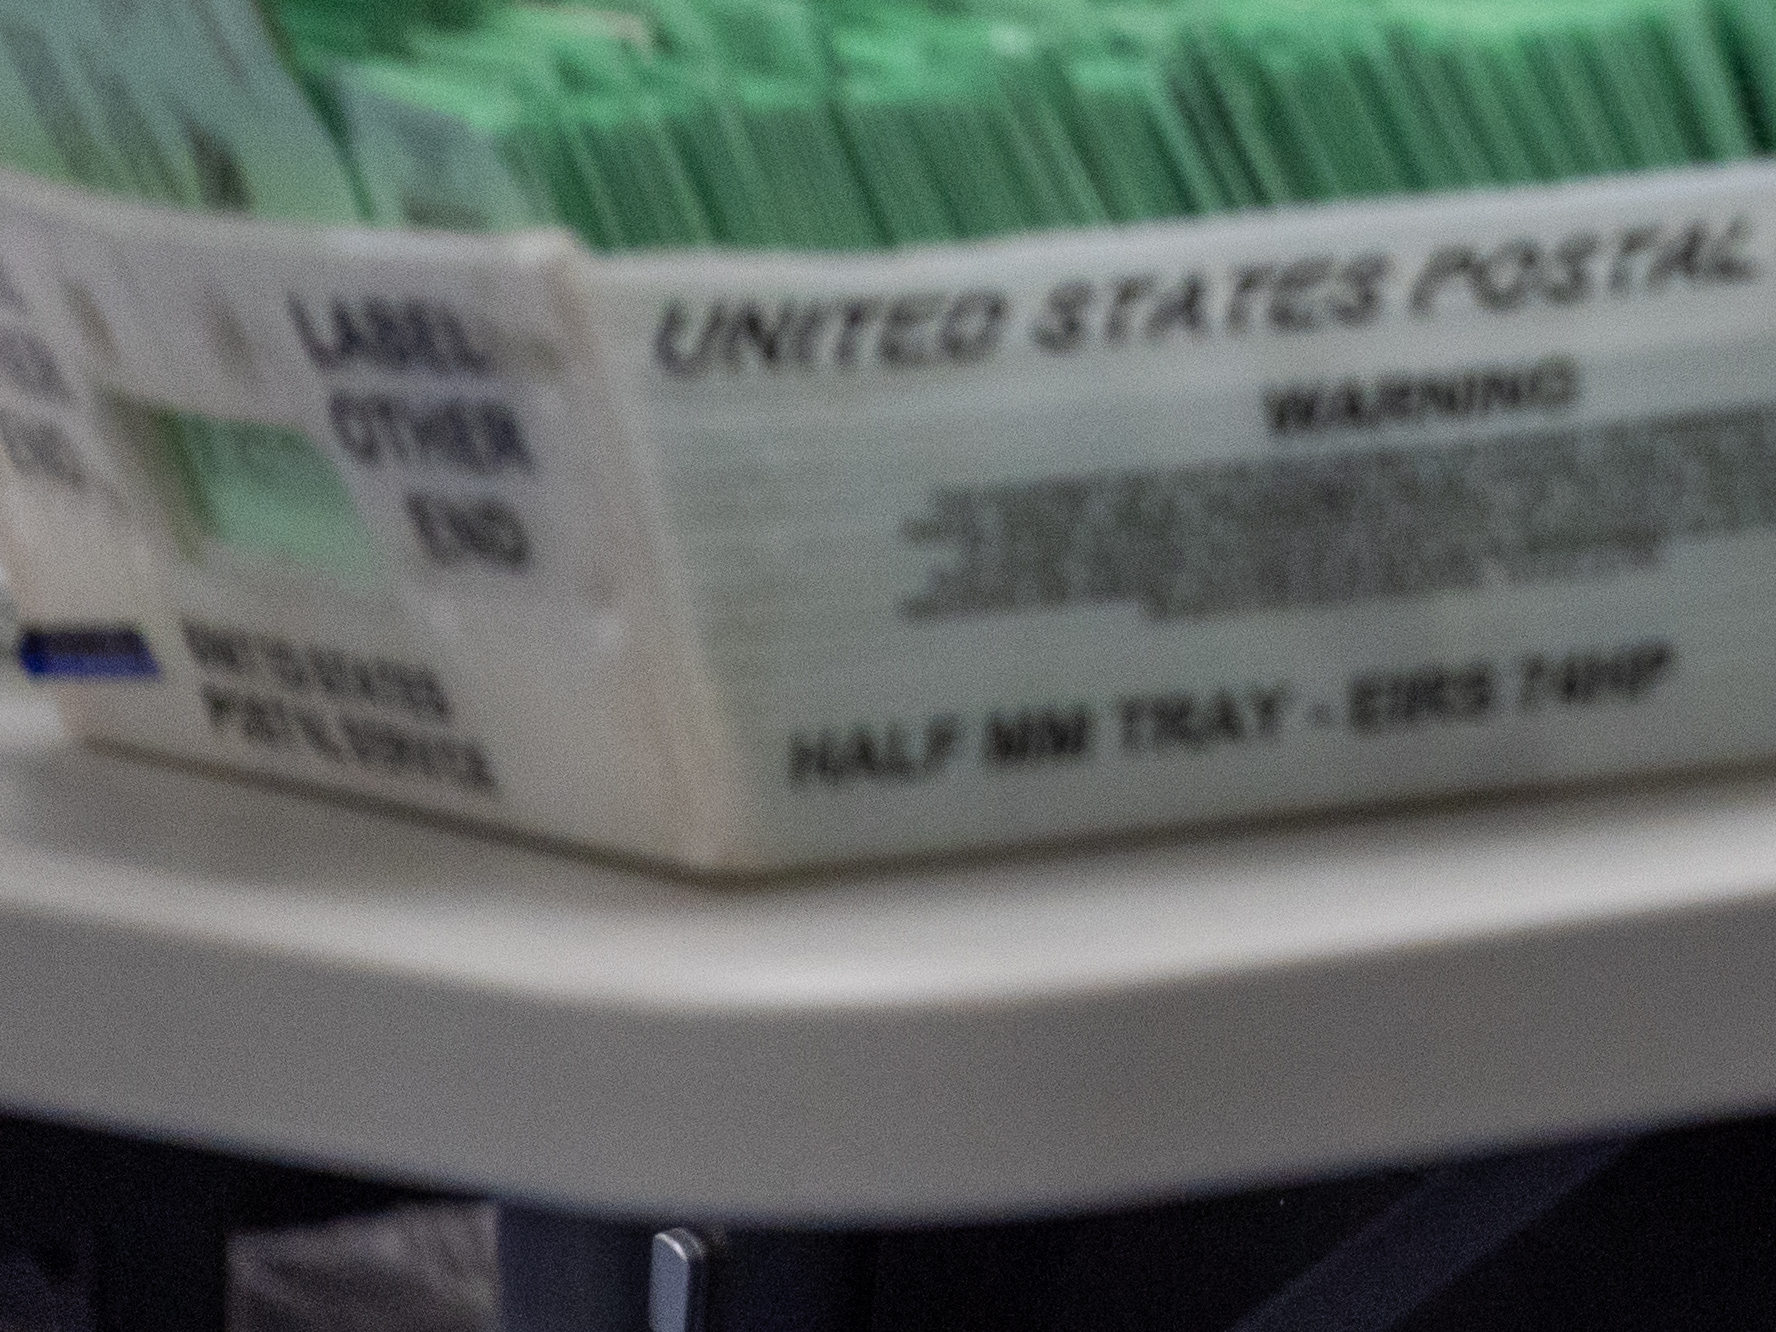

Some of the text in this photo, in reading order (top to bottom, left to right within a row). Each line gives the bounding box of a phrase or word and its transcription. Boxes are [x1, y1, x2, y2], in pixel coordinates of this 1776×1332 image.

[286, 289, 497, 376] LABEL
[653, 284, 1008, 381] UNITED
[1032, 251, 1392, 356] STATES
[1408, 218, 1760, 316] POSTAL
[328, 387, 540, 477] OTHER
[1262, 354, 1580, 436] WARNING
[406, 490, 533, 576] END
[788, 712, 959, 790] HALF
[981, 700, 1092, 772] MM
[1114, 682, 1288, 751] TRAY
